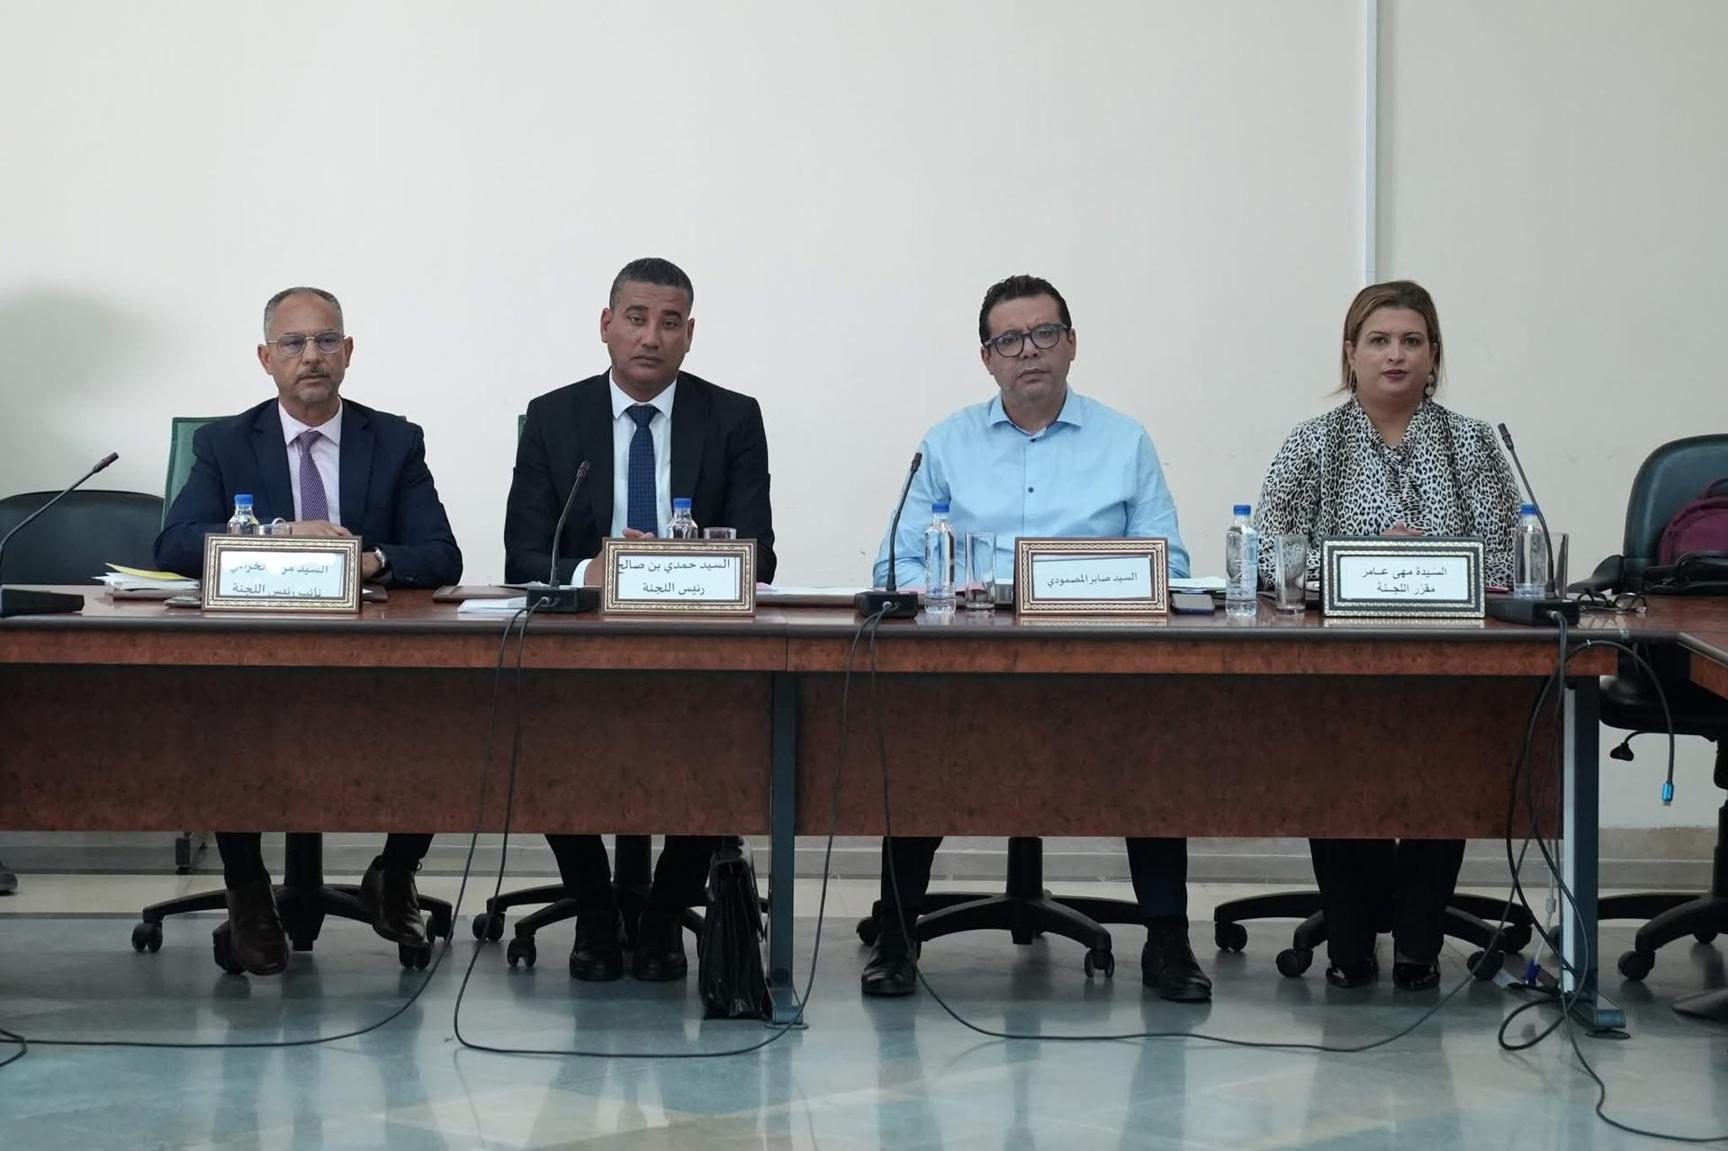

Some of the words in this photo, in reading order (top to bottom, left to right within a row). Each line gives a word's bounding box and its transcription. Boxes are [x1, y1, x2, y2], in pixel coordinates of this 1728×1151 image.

[648, 562, 661, 573] بن
[664, 562, 696, 574] حمدي
[700, 559, 730, 571] السيد
[1047, 572, 1088, 588] المصمودي
[1089, 573, 1111, 585] صابر
[1113, 571, 1138, 584] السيد
[642, 582, 675, 595] اللجنة
[678, 583, 705, 596] رئيس
[1377, 582, 1410, 595] اللجنة
